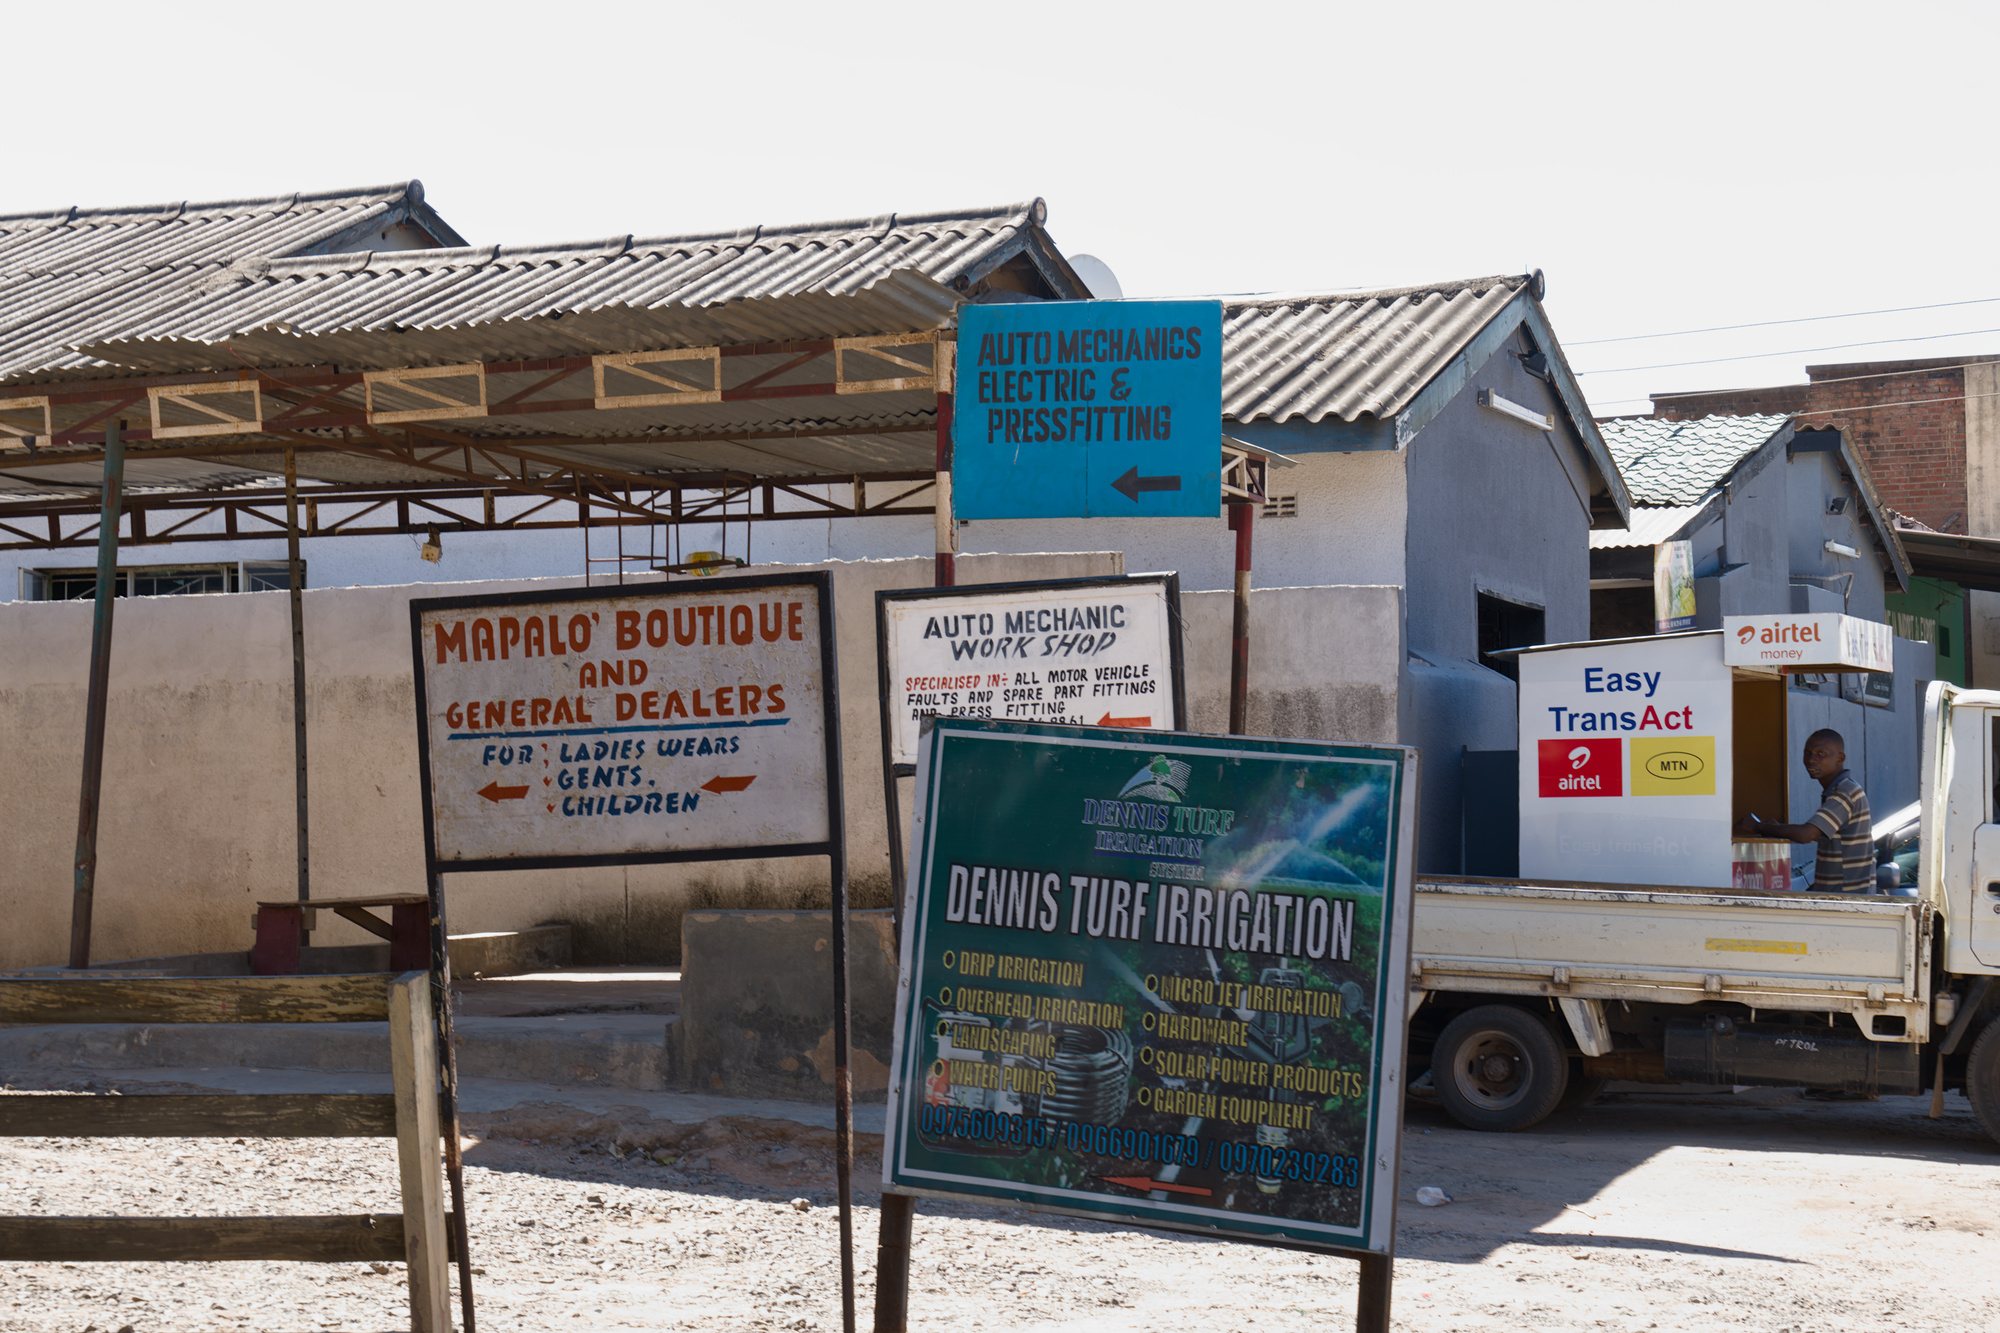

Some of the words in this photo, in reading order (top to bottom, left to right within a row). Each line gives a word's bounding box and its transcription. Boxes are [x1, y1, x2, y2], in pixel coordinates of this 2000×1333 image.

[977, 331, 1051, 366] AUTO
[1057, 326, 1201, 363] MECHANICS
[978, 368, 1096, 403] ELECTRIC
[1109, 367, 1132, 402] &
[434, 612, 600, 664] MAPALO'
[615, 602, 803, 651] BOUTIQUE
[923, 613, 994, 639] AUTO
[1005, 605, 1125, 634] MECHANIC
[1760, 622, 1821, 644] airtel
[950, 636, 1036, 661] WORK
[1040, 632, 1117, 657] SHOP
[1760, 650, 1803, 660] money
[579, 659, 648, 688] AND
[906, 674, 981, 691] SPECIALISED
[1014, 671, 1040, 686] ALL
[1048, 668, 1088, 683] MOTOR
[1095, 664, 1149, 681] VEHICLE
[1584, 667, 1661, 697] Easy
[446, 698, 592, 730] GENERAL
[616, 684, 786, 722] DEALERS
[907, 693, 958, 706] FAULTS
[968, 690, 994, 704] AND
[1003, 687, 1043, 702] SPARE
[1054, 685, 1085, 699] PART
[1093, 680, 1156, 697] FITTINGS
[951, 705, 992, 718] PRESS
[1006, 701, 1066, 717] FITTING
[1548, 705, 1693, 732] TransAct
[560, 739, 645, 763] LADIES
[657, 736, 740, 757] WEARS
[1660, 761, 1688, 771] MTN
[1558, 774, 1601, 790] airtel
[562, 792, 700, 816] CHILDREN
[1081, 798, 1169, 832] DENNIS
[1173, 805, 1235, 836] TURF
[1095, 830, 1204, 858] IRRIGATION
[1149, 861, 1205, 881] SYSTEM
[945, 864, 1061, 933] DENNIS
[1069, 875, 1151, 942] TURF
[1154, 883, 1355, 961] IRRIGATION
[959, 951, 995, 977] DRIP
[997, 955, 1083, 987] IRRIGATION
[956, 987, 1032, 1019] OVERHEAD
[1035, 996, 1124, 1030] IRRIGATION
[1160, 975, 1214, 1005] MICRO
[1217, 981, 1243, 1008] JET
[1246, 985, 1342, 1019] IRRIGATION
[952, 1023, 1056, 1059] LANDSCAPING
[1158, 1013, 1249, 1047] HARDWARE
[949, 1059, 999, 1090] WATER
[1002, 1066, 1057, 1096] PUMPS
[1155, 1050, 1207, 1079] SOLAR
[1210, 1056, 1269, 1087] POWER
[1273, 1063, 1362, 1098] PRODUCTS
[1154, 1087, 1216, 1119] GARDEN
[1220, 1096, 1314, 1130] EQUIPMENT
[921, 1103, 1046, 1148] 0975609315
[1067, 1122, 1199, 1167] 0966901679
[1219, 1141, 1359, 1188] 0970239283
